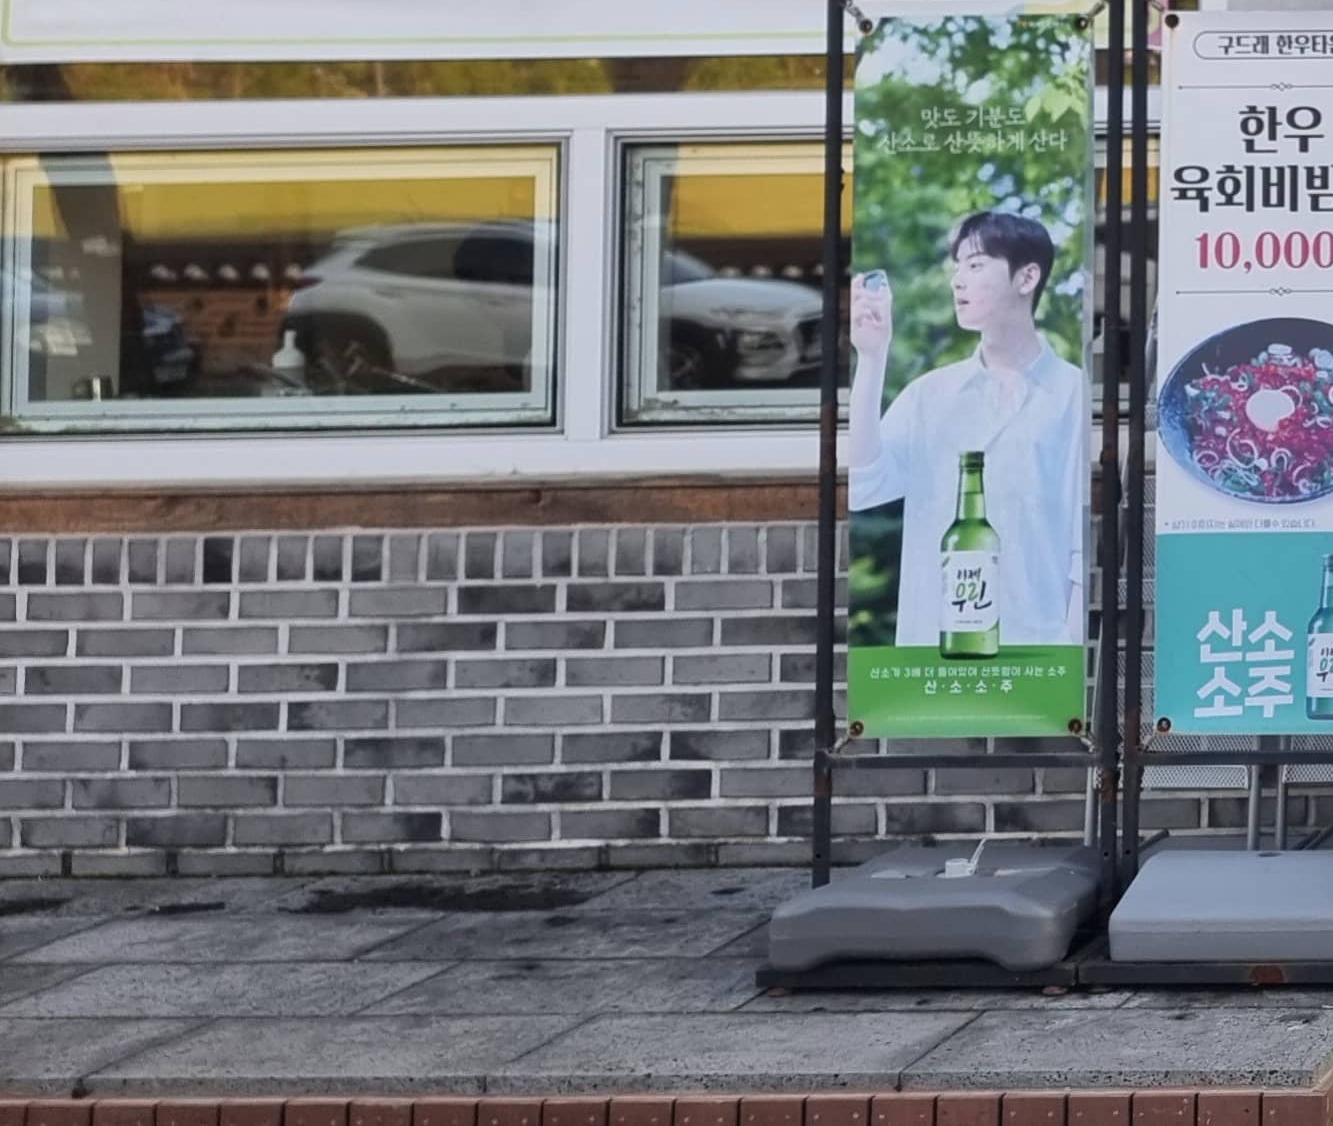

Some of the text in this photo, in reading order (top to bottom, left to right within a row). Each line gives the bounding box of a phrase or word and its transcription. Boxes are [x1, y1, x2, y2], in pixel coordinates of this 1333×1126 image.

[1218, 35, 1269, 55] 구드래
[921, 105, 1026, 129] 맛도 기분도
[1239, 105, 1324, 153] 한우
[944, 129, 1024, 154] 산뜻하게
[1030, 129, 1067, 153] 산다
[1196, 609, 1295, 663] 산소
[1194, 665, 1294, 718] 소주
